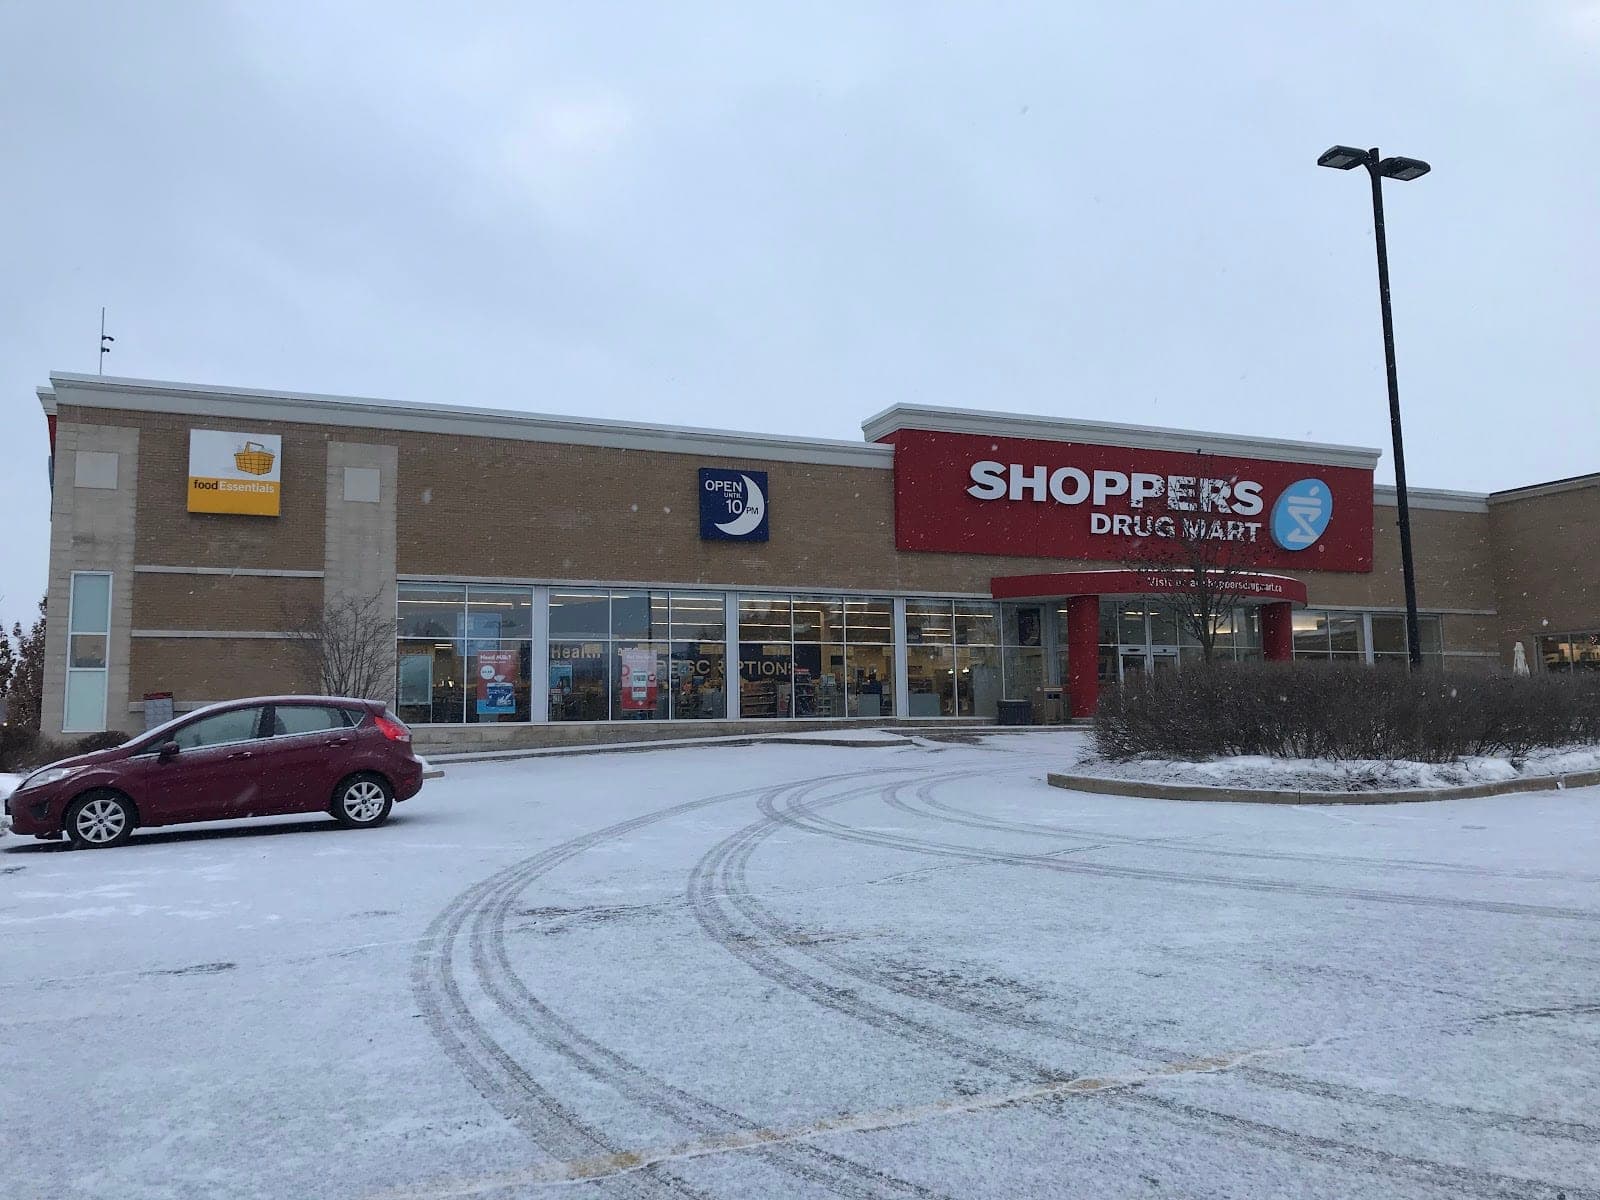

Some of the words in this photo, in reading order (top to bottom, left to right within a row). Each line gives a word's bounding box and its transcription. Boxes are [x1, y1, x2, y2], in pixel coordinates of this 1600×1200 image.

[704, 479, 742, 493] OPEN
[966, 460, 1264, 516] SHOPPERS
[725, 499, 743, 515] 10
[746, 506, 759, 516] PM
[1090, 512, 1176, 539] DRUG
[1181, 518, 1262, 543] MART
